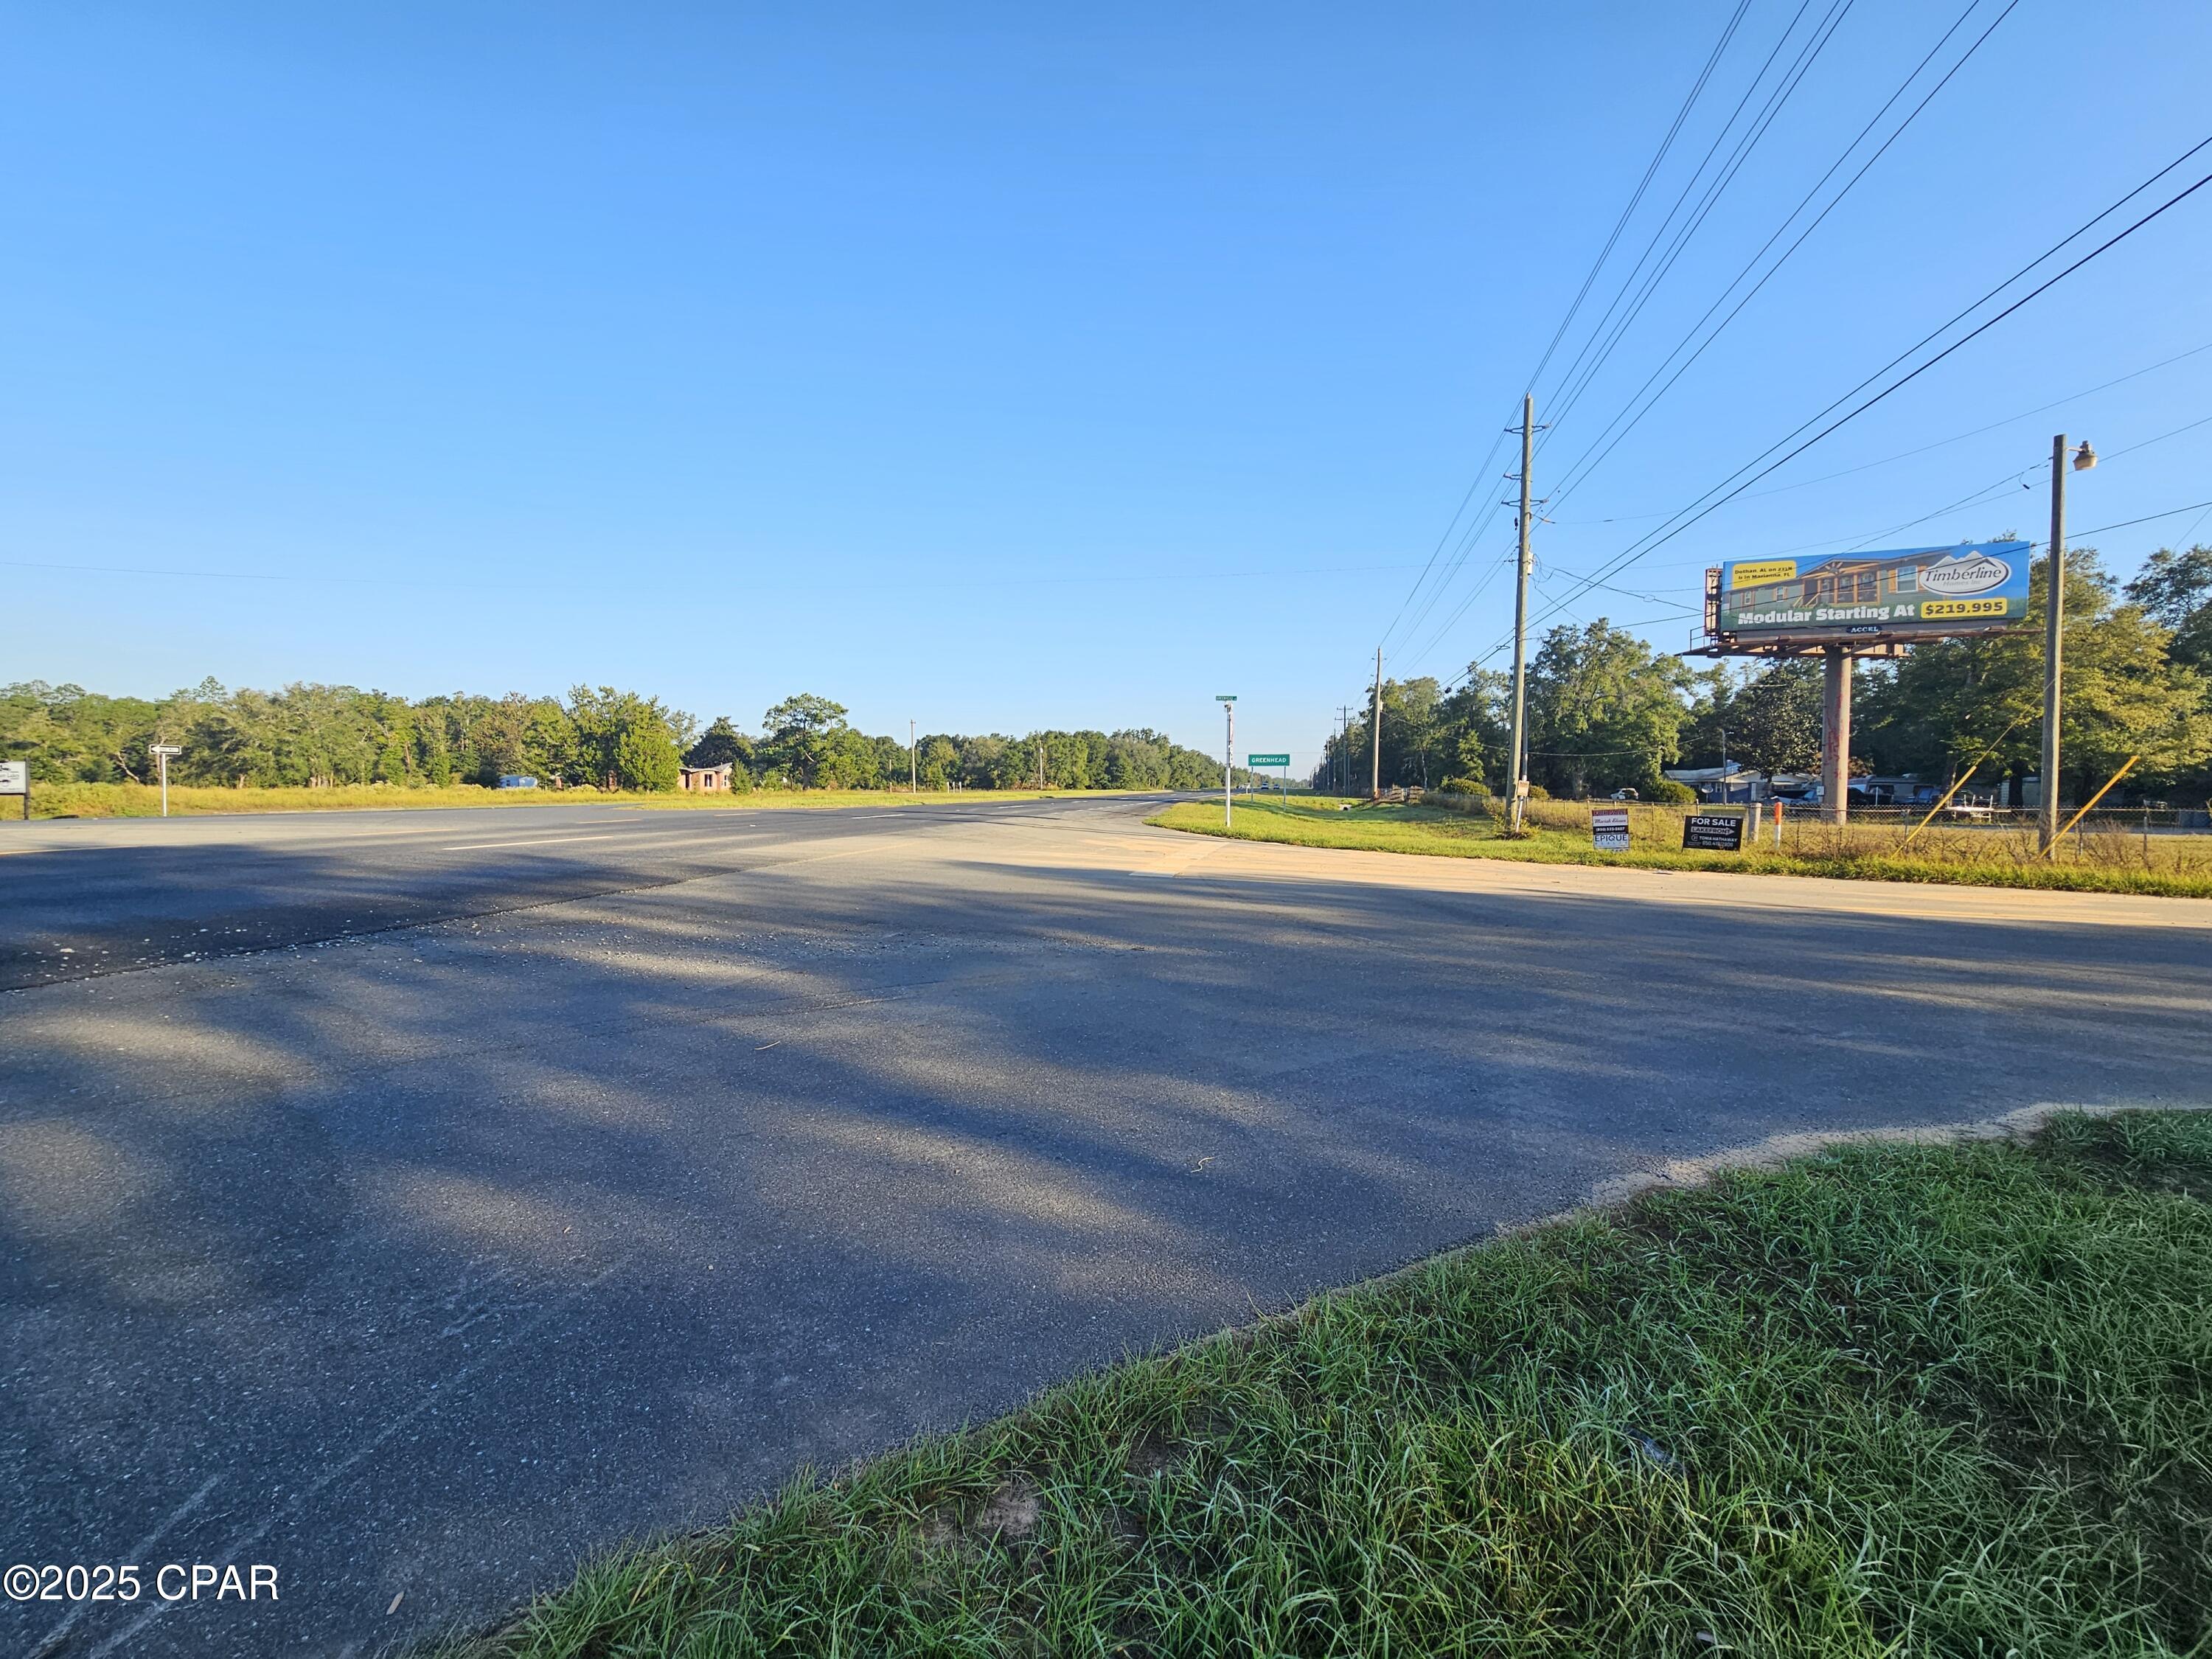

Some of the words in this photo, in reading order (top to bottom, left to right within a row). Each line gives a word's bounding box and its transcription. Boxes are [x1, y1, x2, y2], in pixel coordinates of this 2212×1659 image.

[1925, 567, 2002, 582] Timberline
[1738, 610, 1812, 625] Modular
[1816, 606, 1891, 620] Starting
[1893, 605, 1915, 617] At
[1712, 818, 1736, 827] SALE
